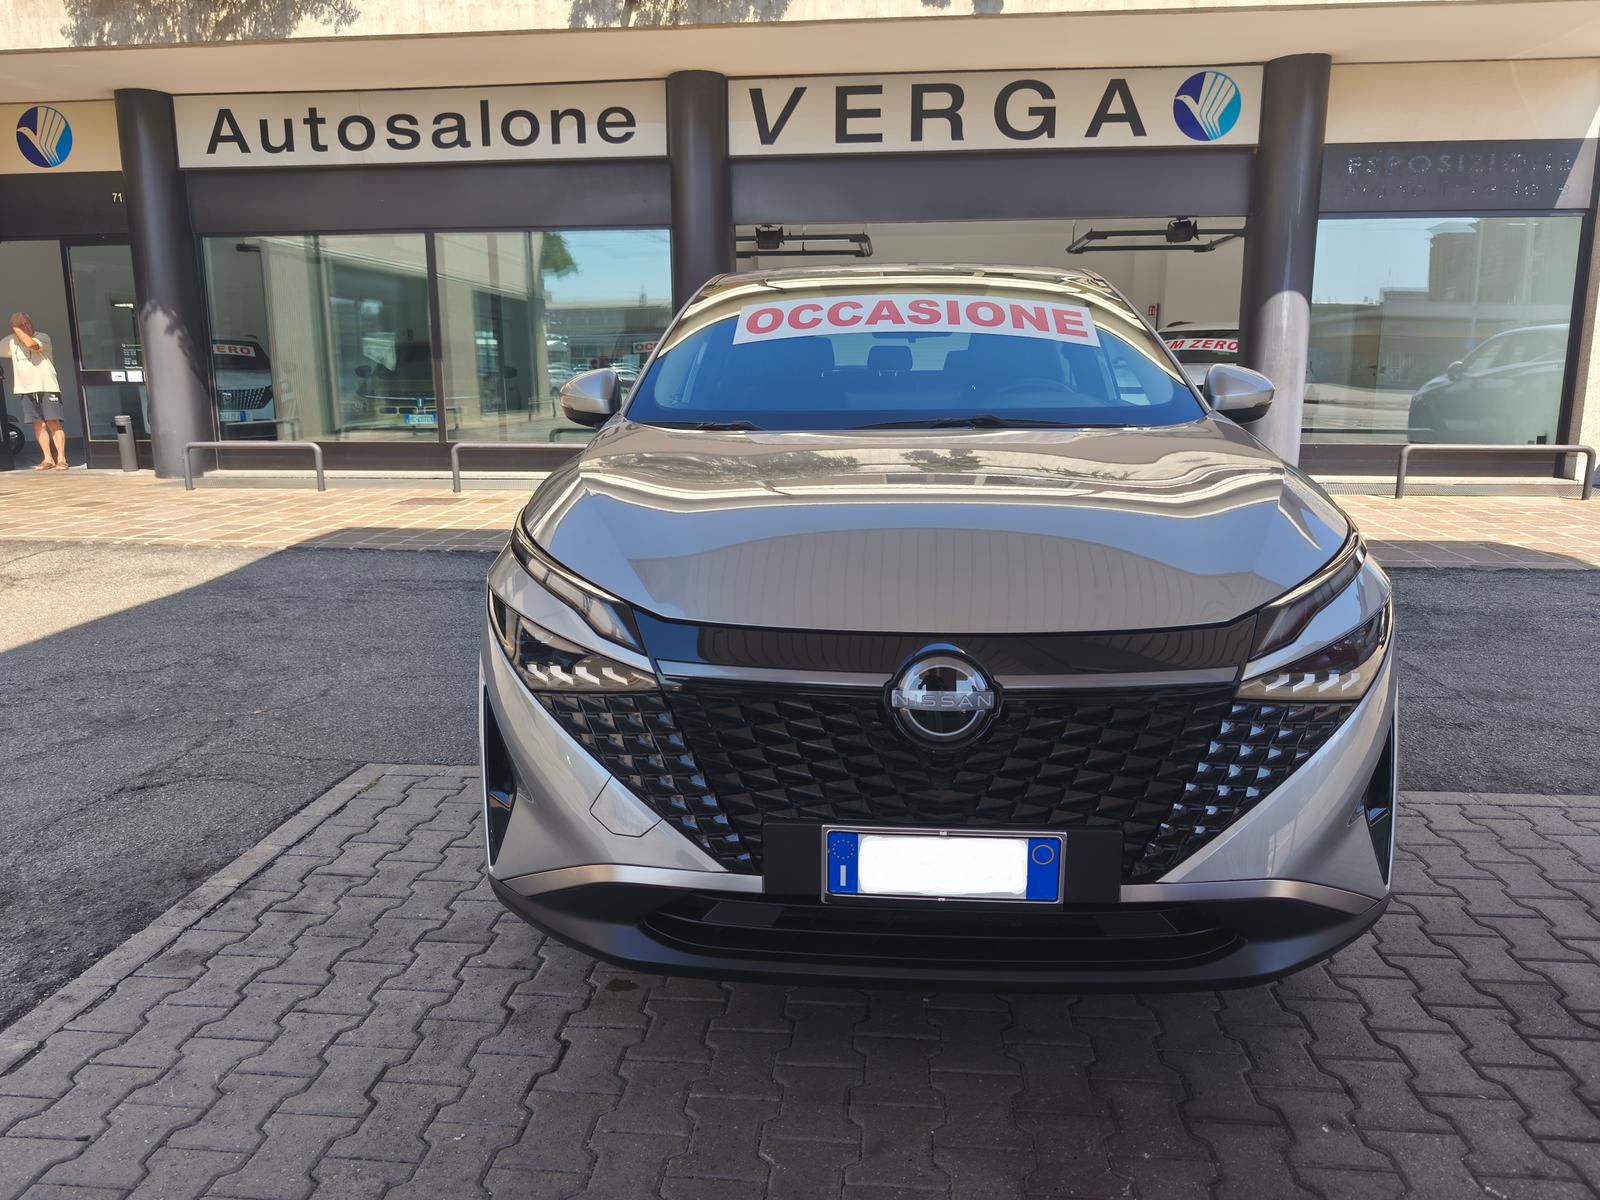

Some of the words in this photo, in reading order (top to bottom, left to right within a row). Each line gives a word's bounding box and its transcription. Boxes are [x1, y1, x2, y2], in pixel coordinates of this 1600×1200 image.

[205, 99, 636, 155] Autosalone
[748, 78, 1147, 145] VERGA
[112, 192, 122, 203] 71
[745, 299, 1089, 338] OCCASIONE
[1188, 340, 1239, 351] ZERO
[894, 694, 993, 707] NISSAN
